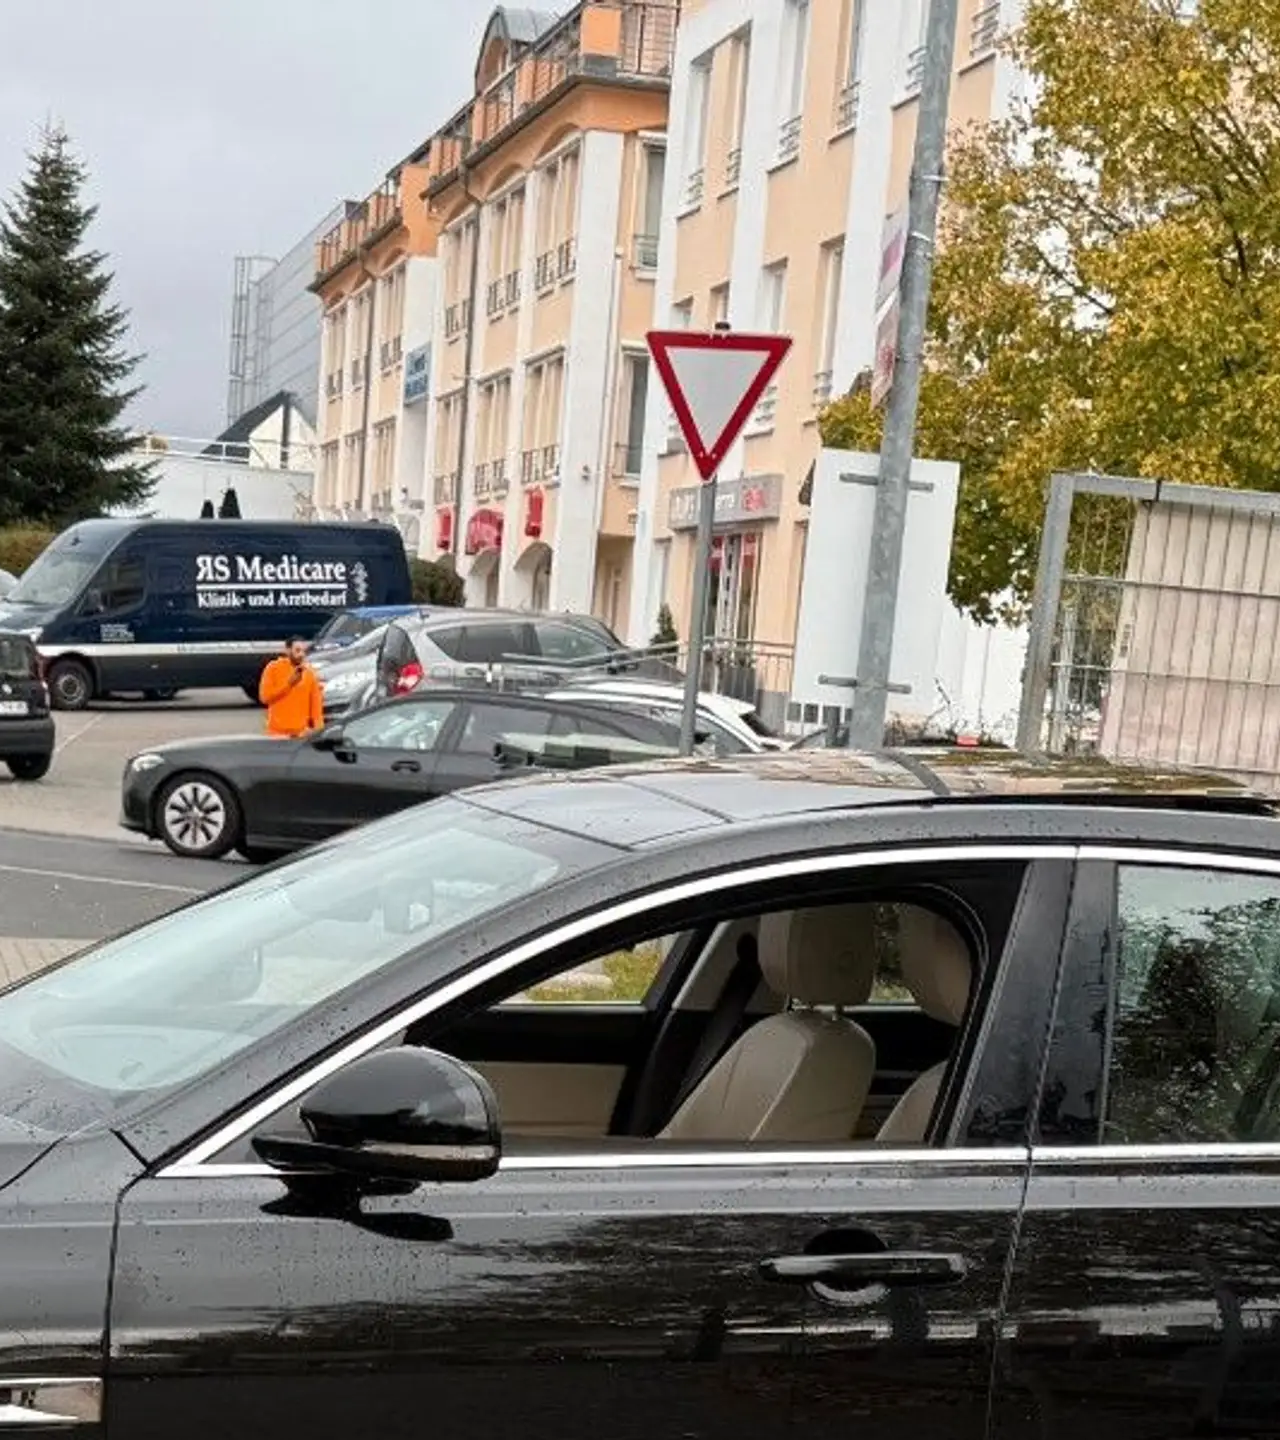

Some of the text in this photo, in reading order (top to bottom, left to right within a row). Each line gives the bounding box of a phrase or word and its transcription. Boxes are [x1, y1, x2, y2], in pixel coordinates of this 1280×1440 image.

[234, 554, 346, 581] Medicare
[198, 591, 245, 608] Klinik-
[248, 590, 274, 606] und
